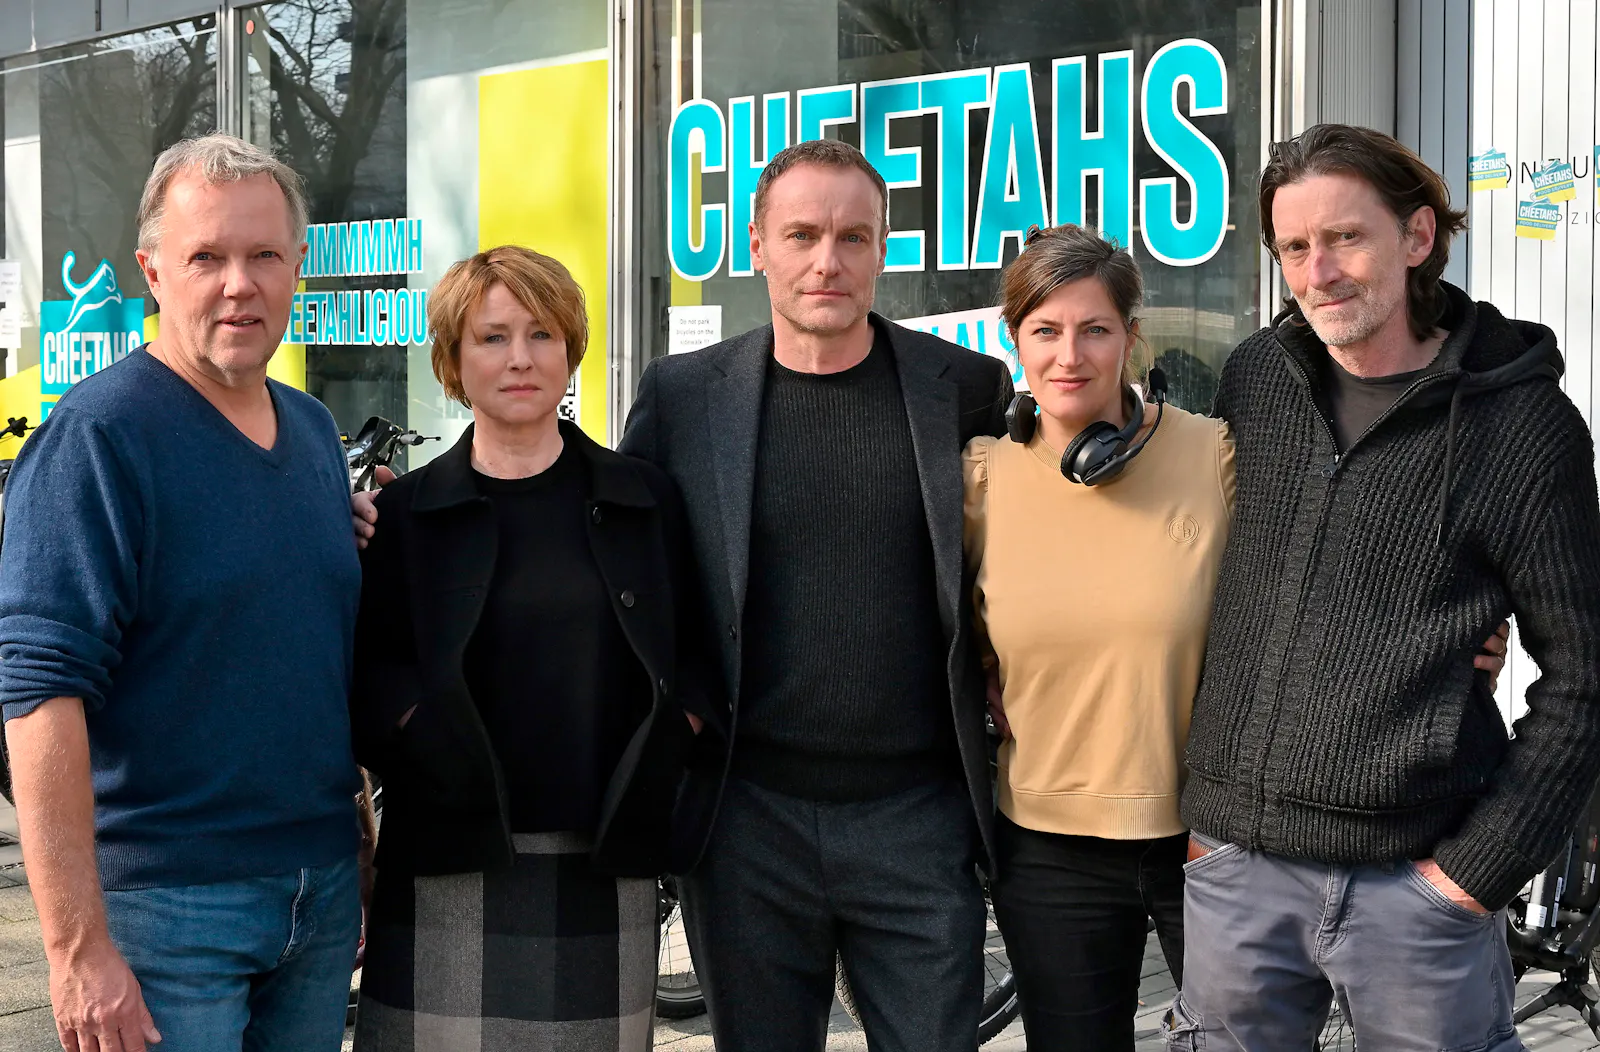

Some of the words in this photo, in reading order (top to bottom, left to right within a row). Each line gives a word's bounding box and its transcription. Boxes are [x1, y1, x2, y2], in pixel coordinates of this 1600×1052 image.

[1470, 157, 1506, 173] CHEETAHS
[1534, 168, 1572, 188] CHEETAHS
[1520, 206, 1557, 221] CHEETAHS
[281, 288, 435, 346] EETAHLICIOU
[698, 318, 710, 326] park
